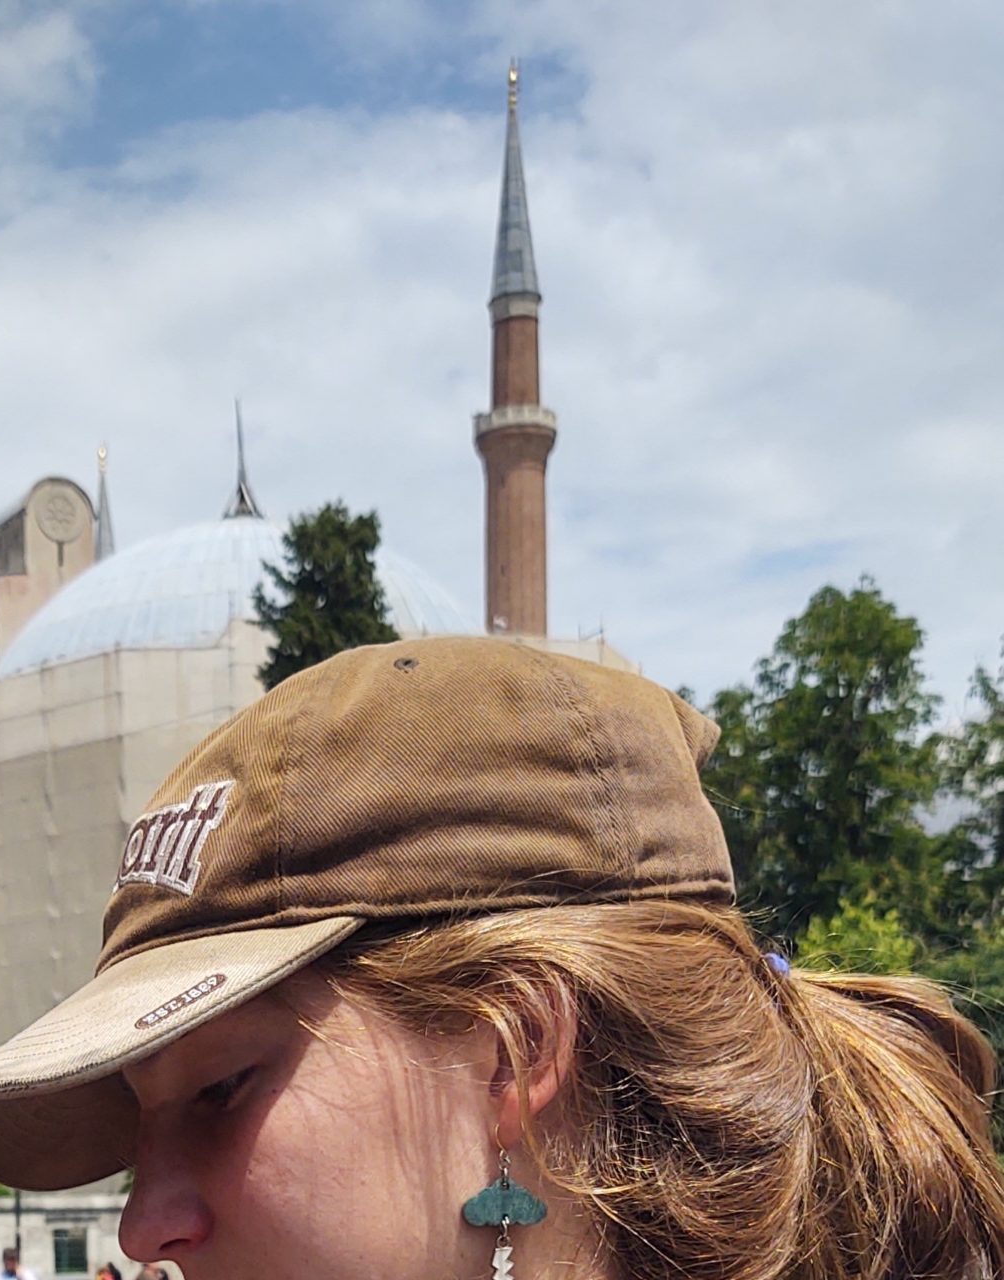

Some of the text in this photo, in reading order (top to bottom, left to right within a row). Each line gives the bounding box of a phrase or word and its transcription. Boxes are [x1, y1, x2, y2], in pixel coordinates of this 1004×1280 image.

[117, 780, 236, 896] artt
[142, 976, 218, 1025] EST. 1889
